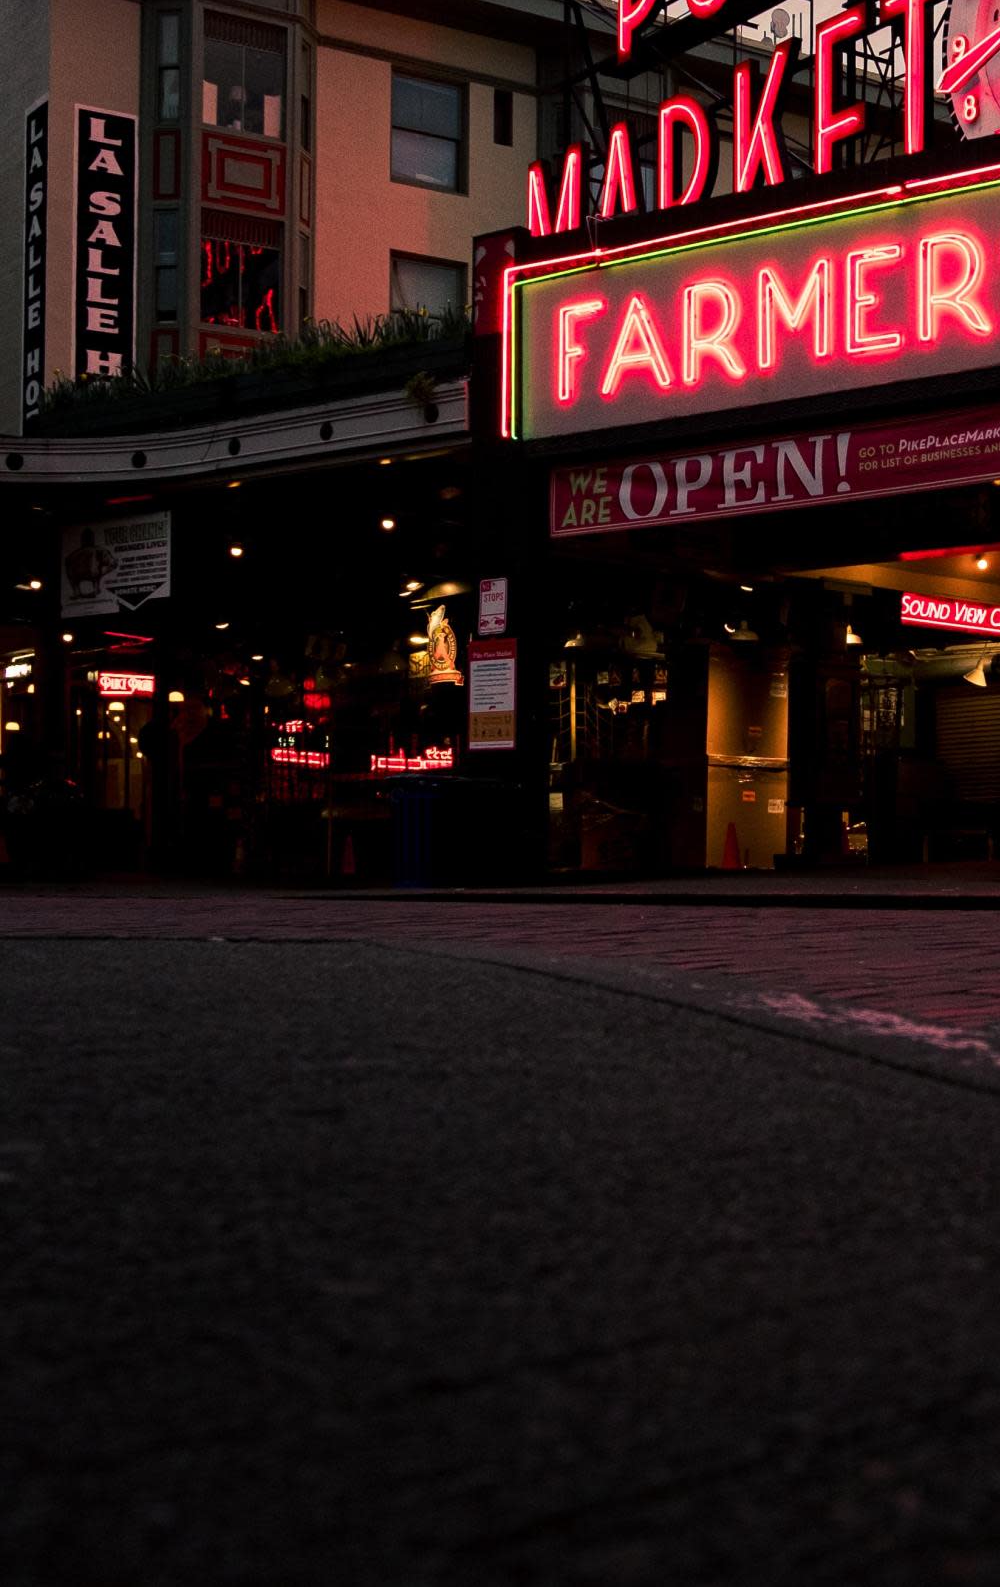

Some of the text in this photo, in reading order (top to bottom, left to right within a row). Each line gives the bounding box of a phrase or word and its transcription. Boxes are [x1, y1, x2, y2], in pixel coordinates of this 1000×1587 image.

[963, 94, 980, 124] 8
[87, 117, 125, 176] LA
[25, 117, 44, 418] LA SALLE HO
[85, 191, 123, 334] SALLE
[859, 447, 876, 458] GO
[880, 444, 895, 454] TO
[859, 461, 878, 472] FOR
[881, 457, 901, 469] LIST
[904, 455, 918, 465] OF
[921, 445, 981, 463] BUSINESSES
[569, 467, 608, 496] WE
[618, 432, 852, 521] OPEN!
[561, 496, 613, 527] ARE
[484, 592, 504, 603] STOPS
[901, 595, 950, 620] SOUND
[955, 602, 986, 624] VIEW
